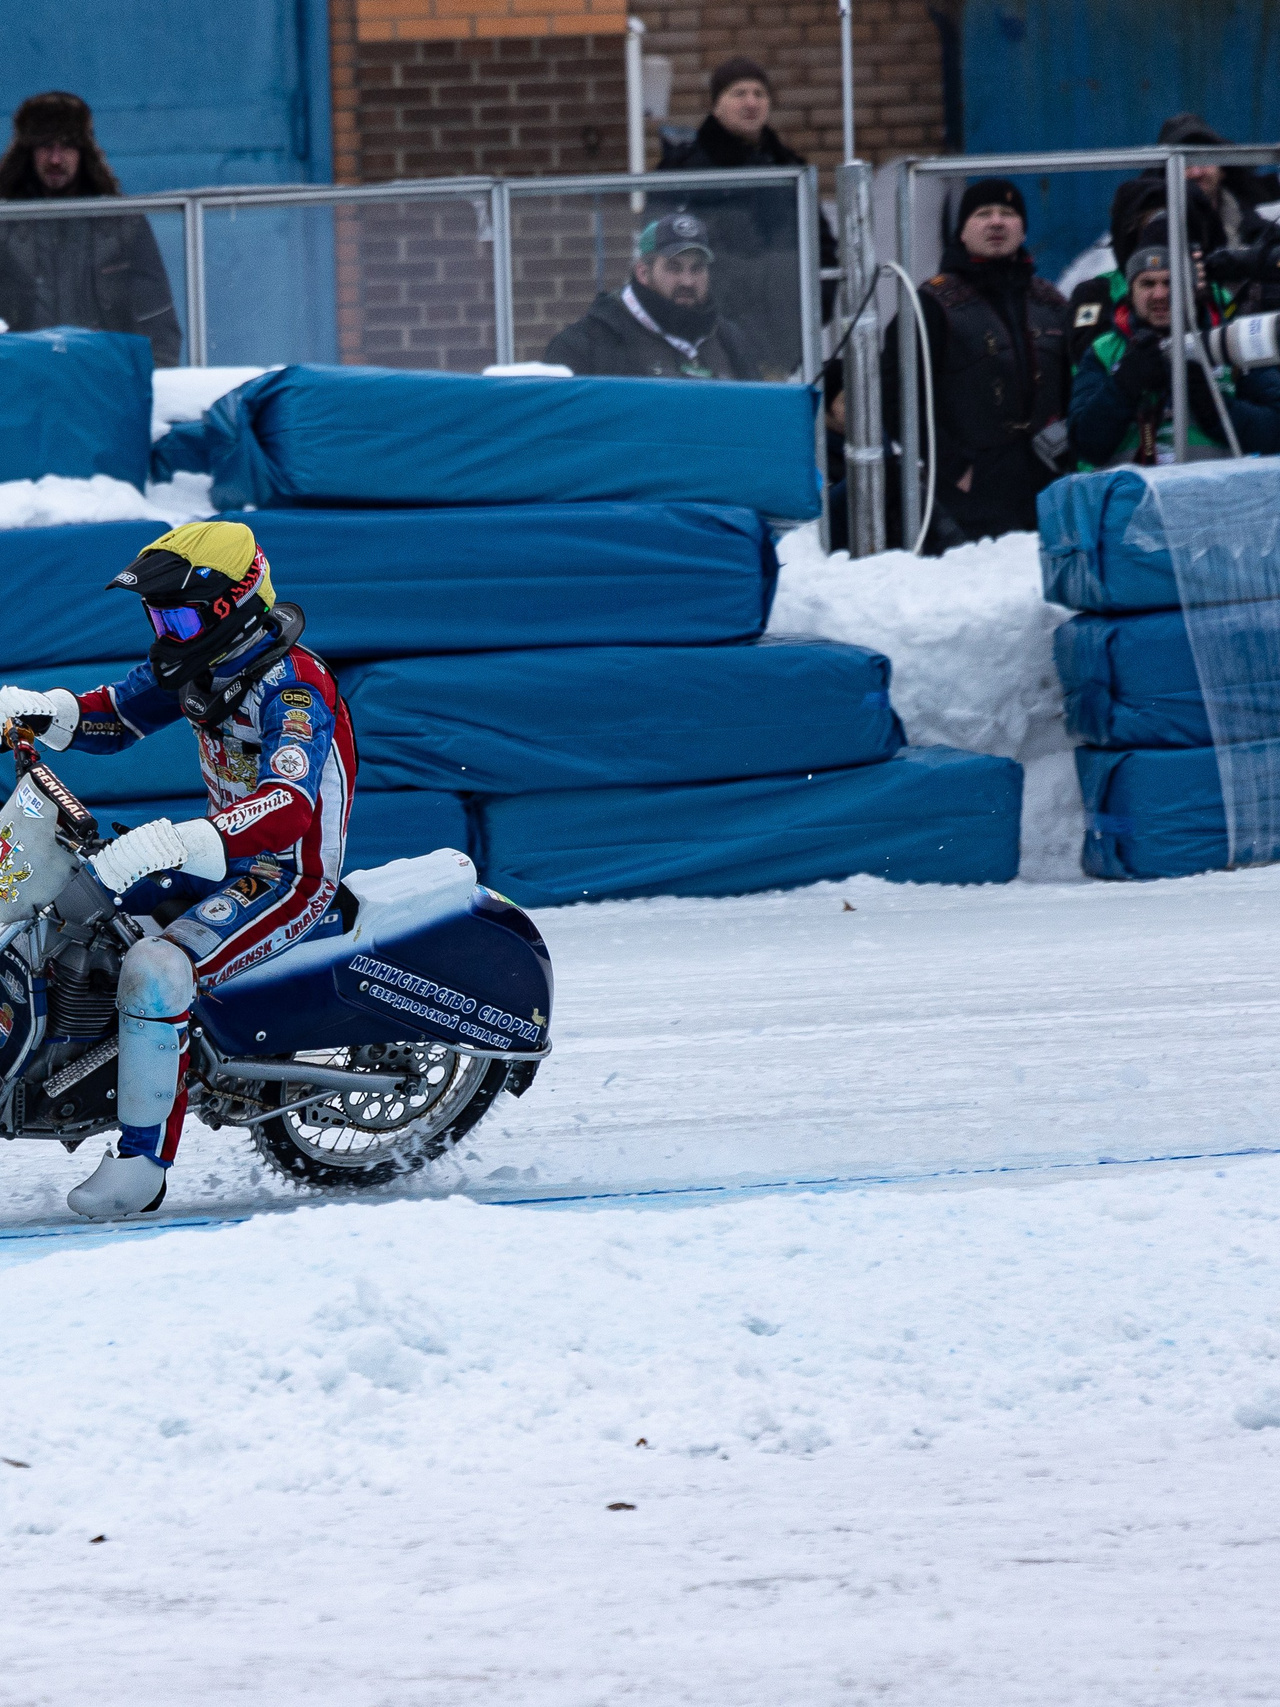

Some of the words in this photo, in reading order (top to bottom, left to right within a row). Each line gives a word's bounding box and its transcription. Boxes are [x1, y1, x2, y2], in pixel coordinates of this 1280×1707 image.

[31, 766, 86, 821] RENTHAL
[216, 790, 294, 829] Спутник
[207, 939, 273, 988] KAMENSK
[348, 953, 477, 1016] МИНИСТЕРСТВО
[477, 1004, 542, 1043] СПОРТА
[368, 984, 460, 1031] СВЕРДЛОВСКОЙ
[459, 1020, 513, 1050] ОБЛАСТИ
